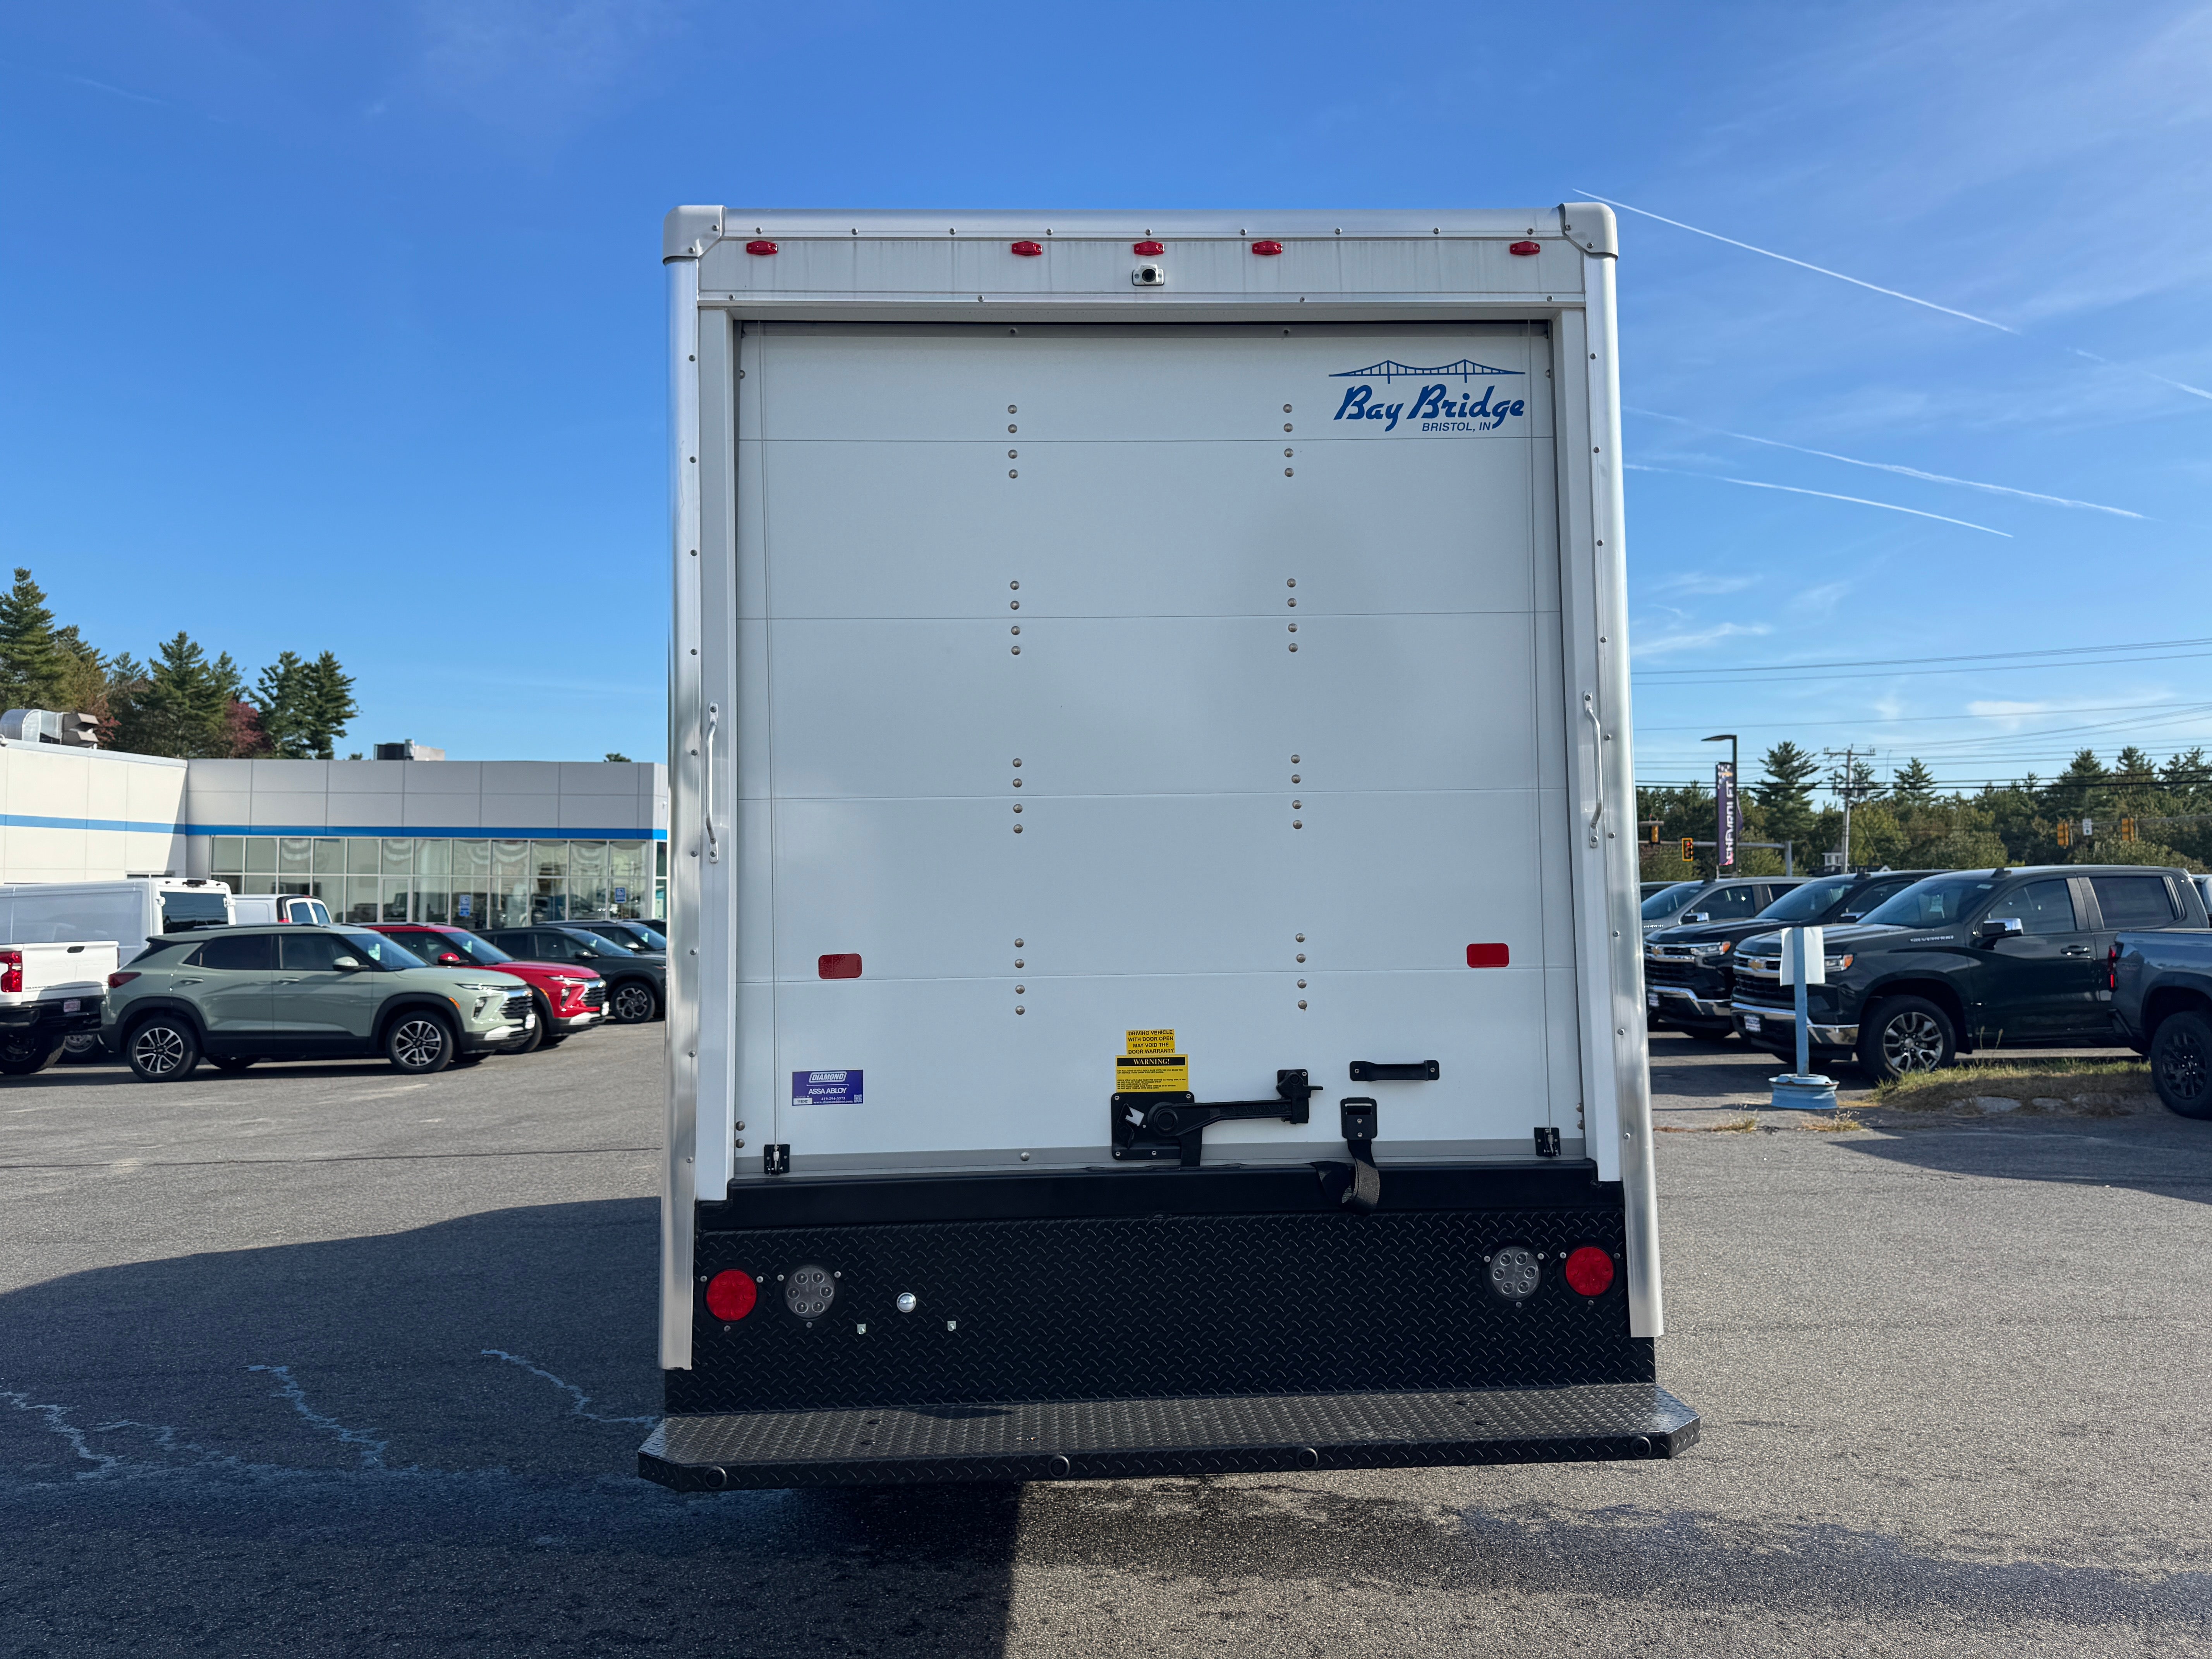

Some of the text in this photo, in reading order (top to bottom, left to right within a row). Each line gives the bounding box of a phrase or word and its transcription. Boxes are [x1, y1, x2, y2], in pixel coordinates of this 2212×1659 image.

[1333, 383, 1525, 432] Bay Bridge
[1422, 422, 1491, 433] BRISTOL, IN
